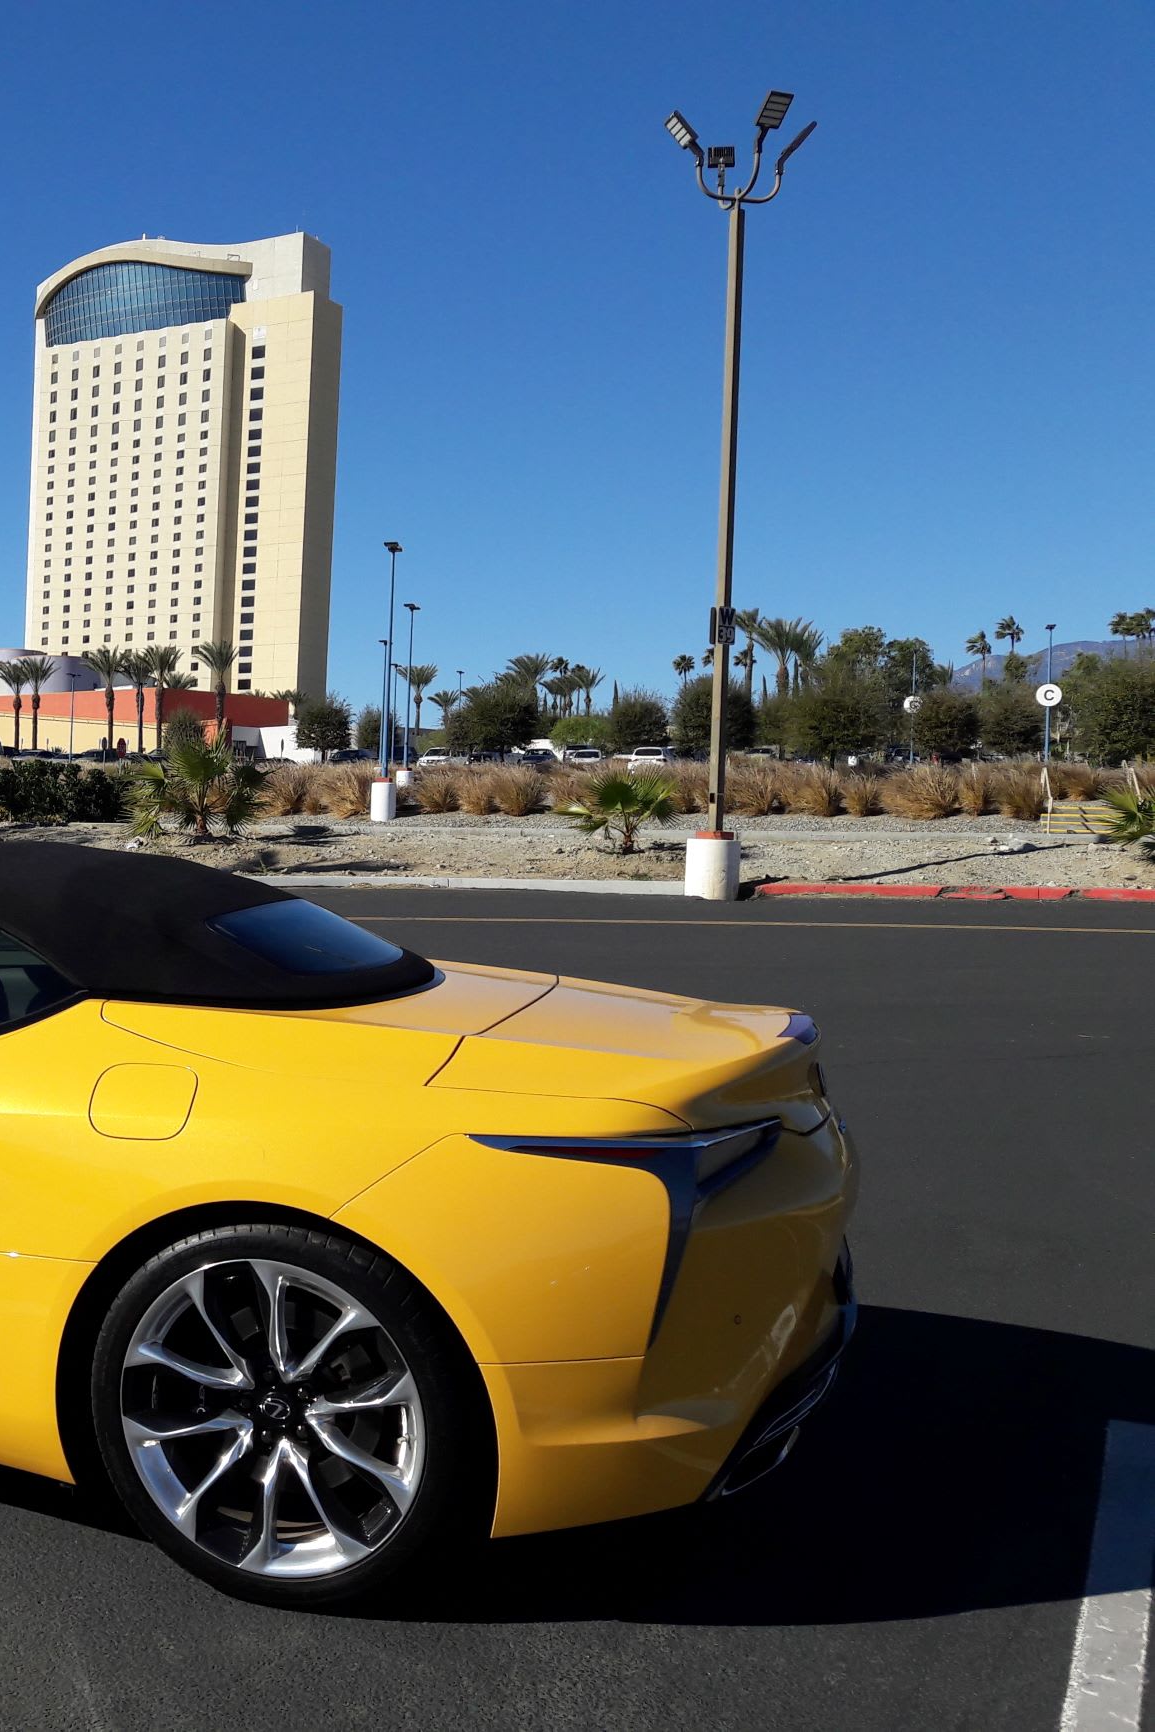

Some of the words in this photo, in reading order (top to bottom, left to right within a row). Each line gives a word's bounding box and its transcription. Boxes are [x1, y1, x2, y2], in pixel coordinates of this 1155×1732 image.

[720, 608, 735, 625] W
[719, 627, 734, 643] 39
[1044, 690, 1055, 701] C
